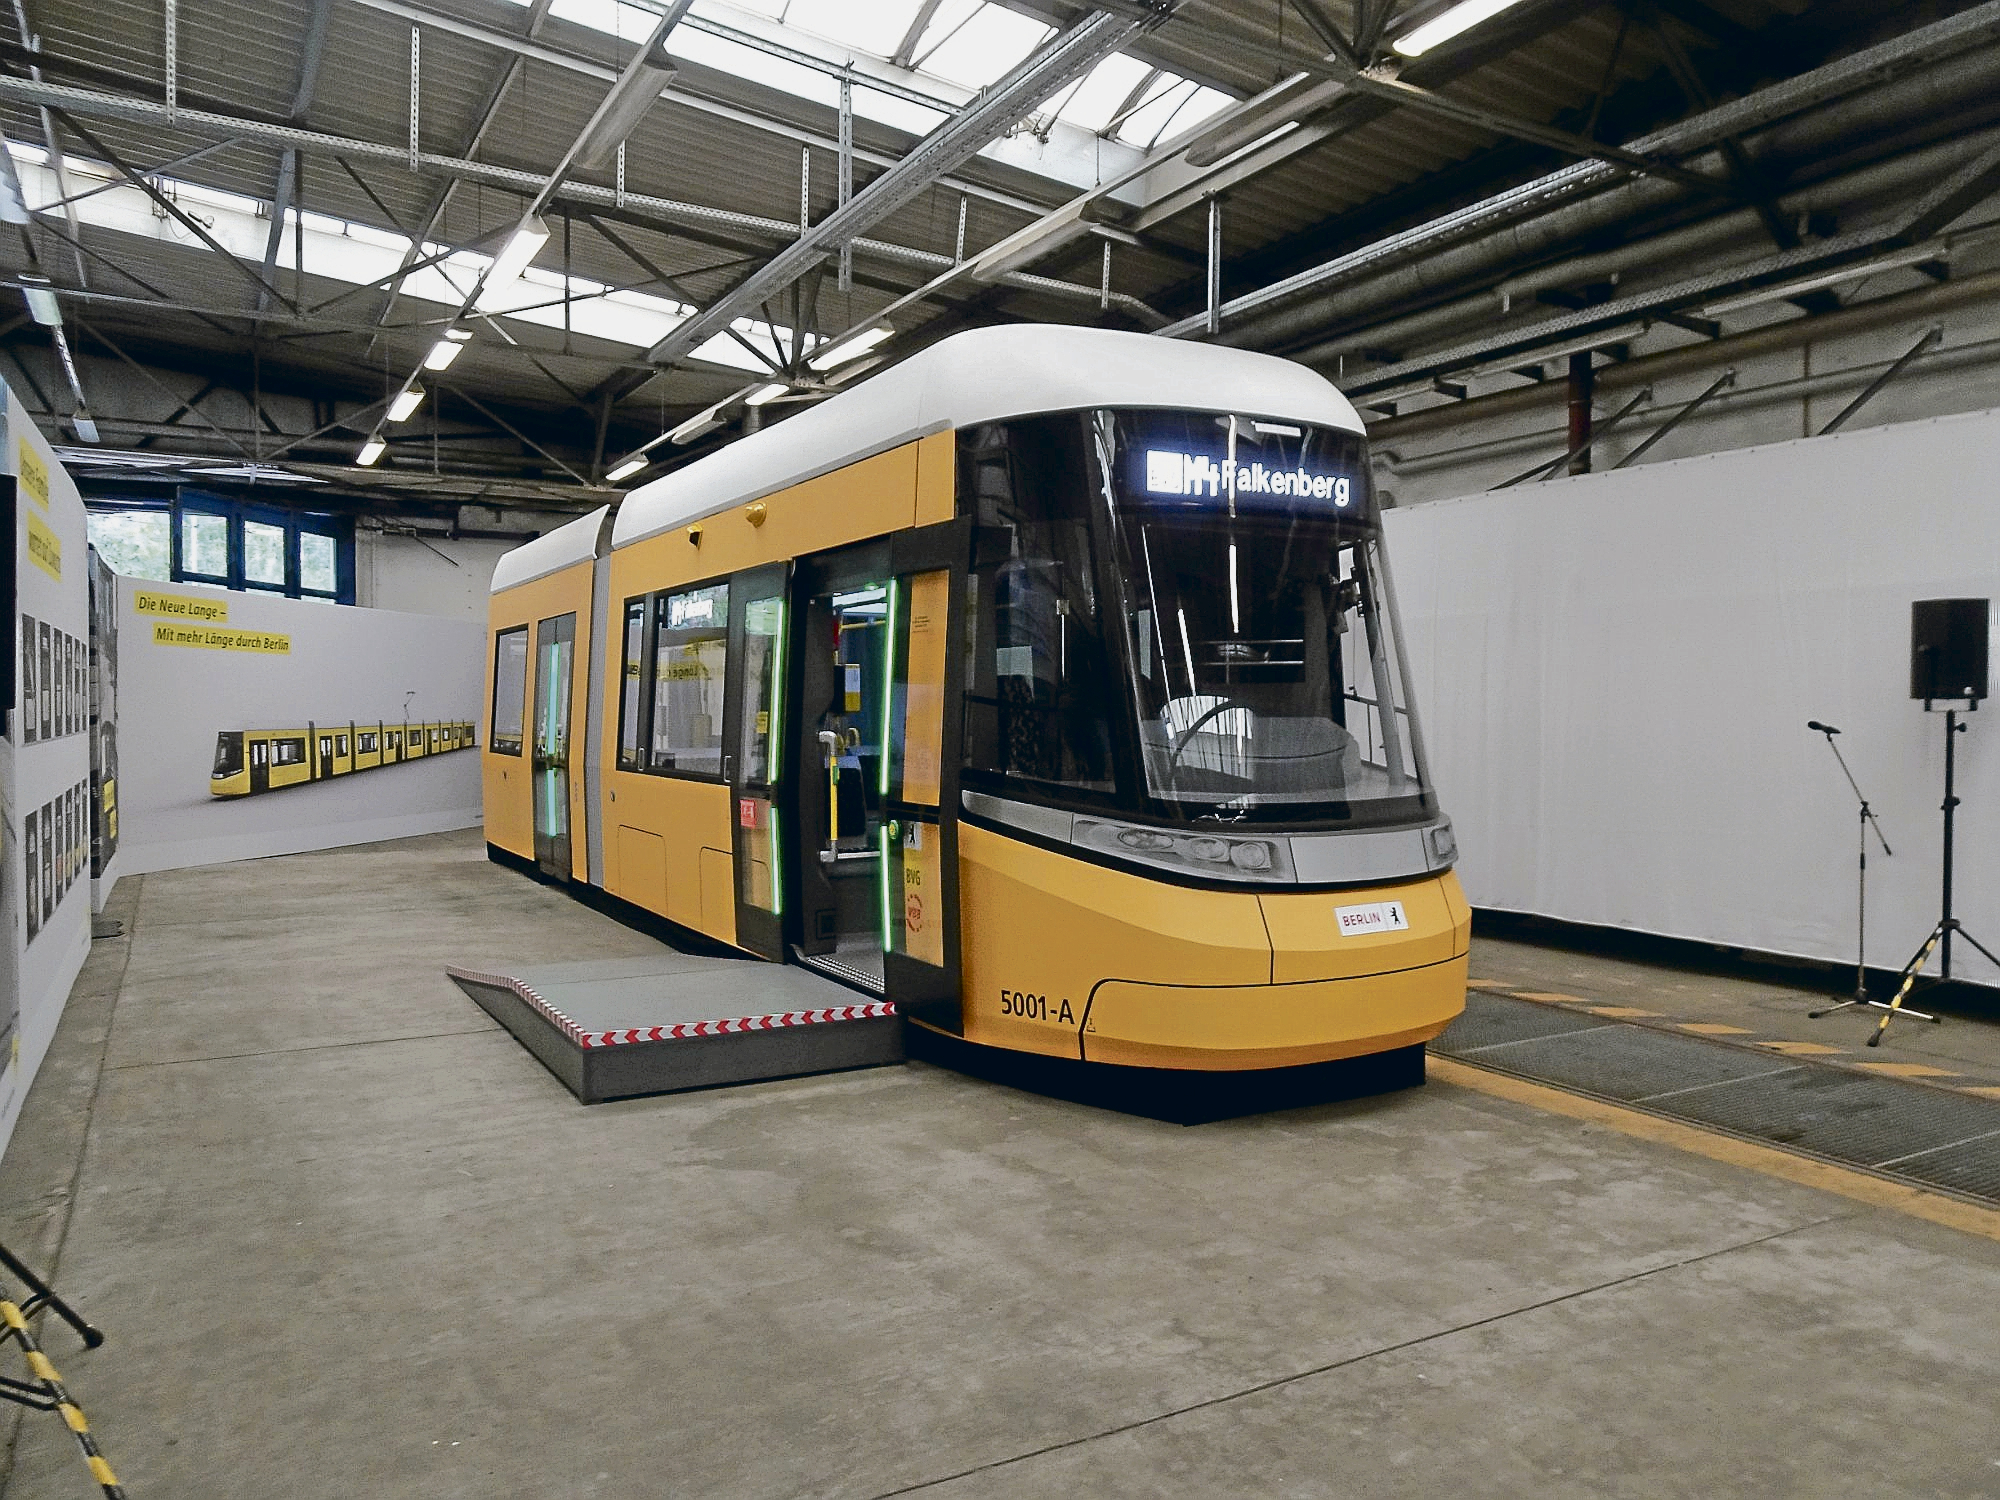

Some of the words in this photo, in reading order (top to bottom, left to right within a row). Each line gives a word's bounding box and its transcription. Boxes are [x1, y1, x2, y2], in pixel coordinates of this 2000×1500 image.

[1222, 460, 1349, 507] Falkenberg
[138, 597, 156, 611] Die
[159, 599, 185, 614] Neue
[188, 603, 218, 620] Lange
[156, 627, 174, 642] Mit
[176, 630, 203, 644] mehr
[205, 632, 233, 648] Länge
[236, 635, 262, 649] durch
[263, 638, 288, 651] Berlin
[906, 868, 920, 885] BVG
[1342, 912, 1381, 927] BERLIN
[1001, 990, 1075, 1025] 5001-A
